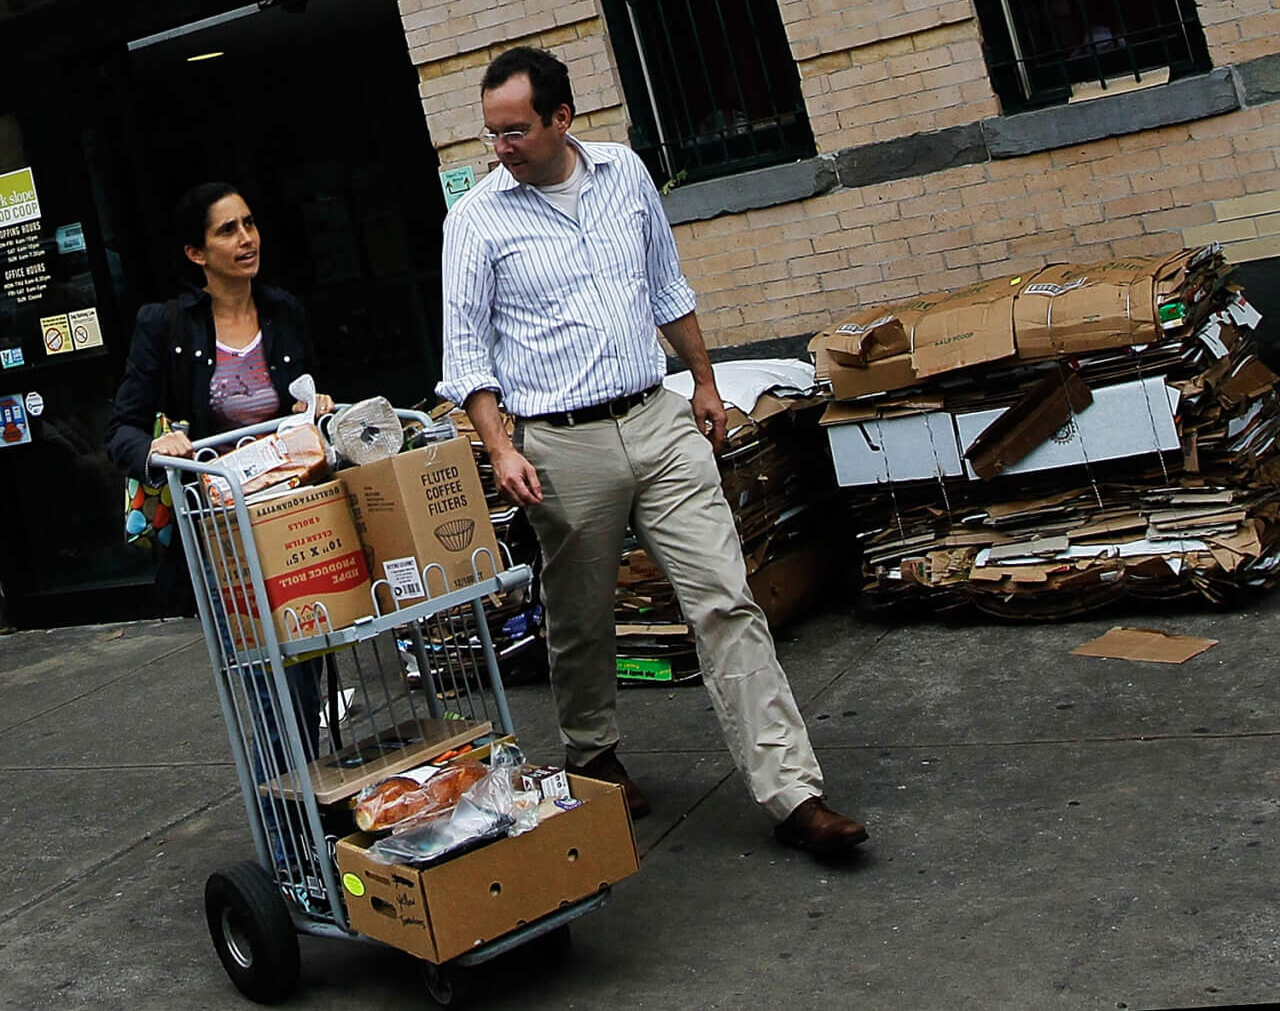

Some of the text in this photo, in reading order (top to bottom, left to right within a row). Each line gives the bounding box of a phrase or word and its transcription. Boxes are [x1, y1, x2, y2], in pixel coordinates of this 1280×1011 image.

[10, 190, 35, 206] slope
[13, 202, 38, 219] COOP
[421, 466, 459, 487] FLUTED
[426, 480, 463, 501] COFFEE
[256, 499, 299, 517] QUANTITY
[428, 494, 468, 516] FILTERS
[288, 518, 316, 531] ROLLS
[279, 557, 356, 587] PRODUCE ROLL
